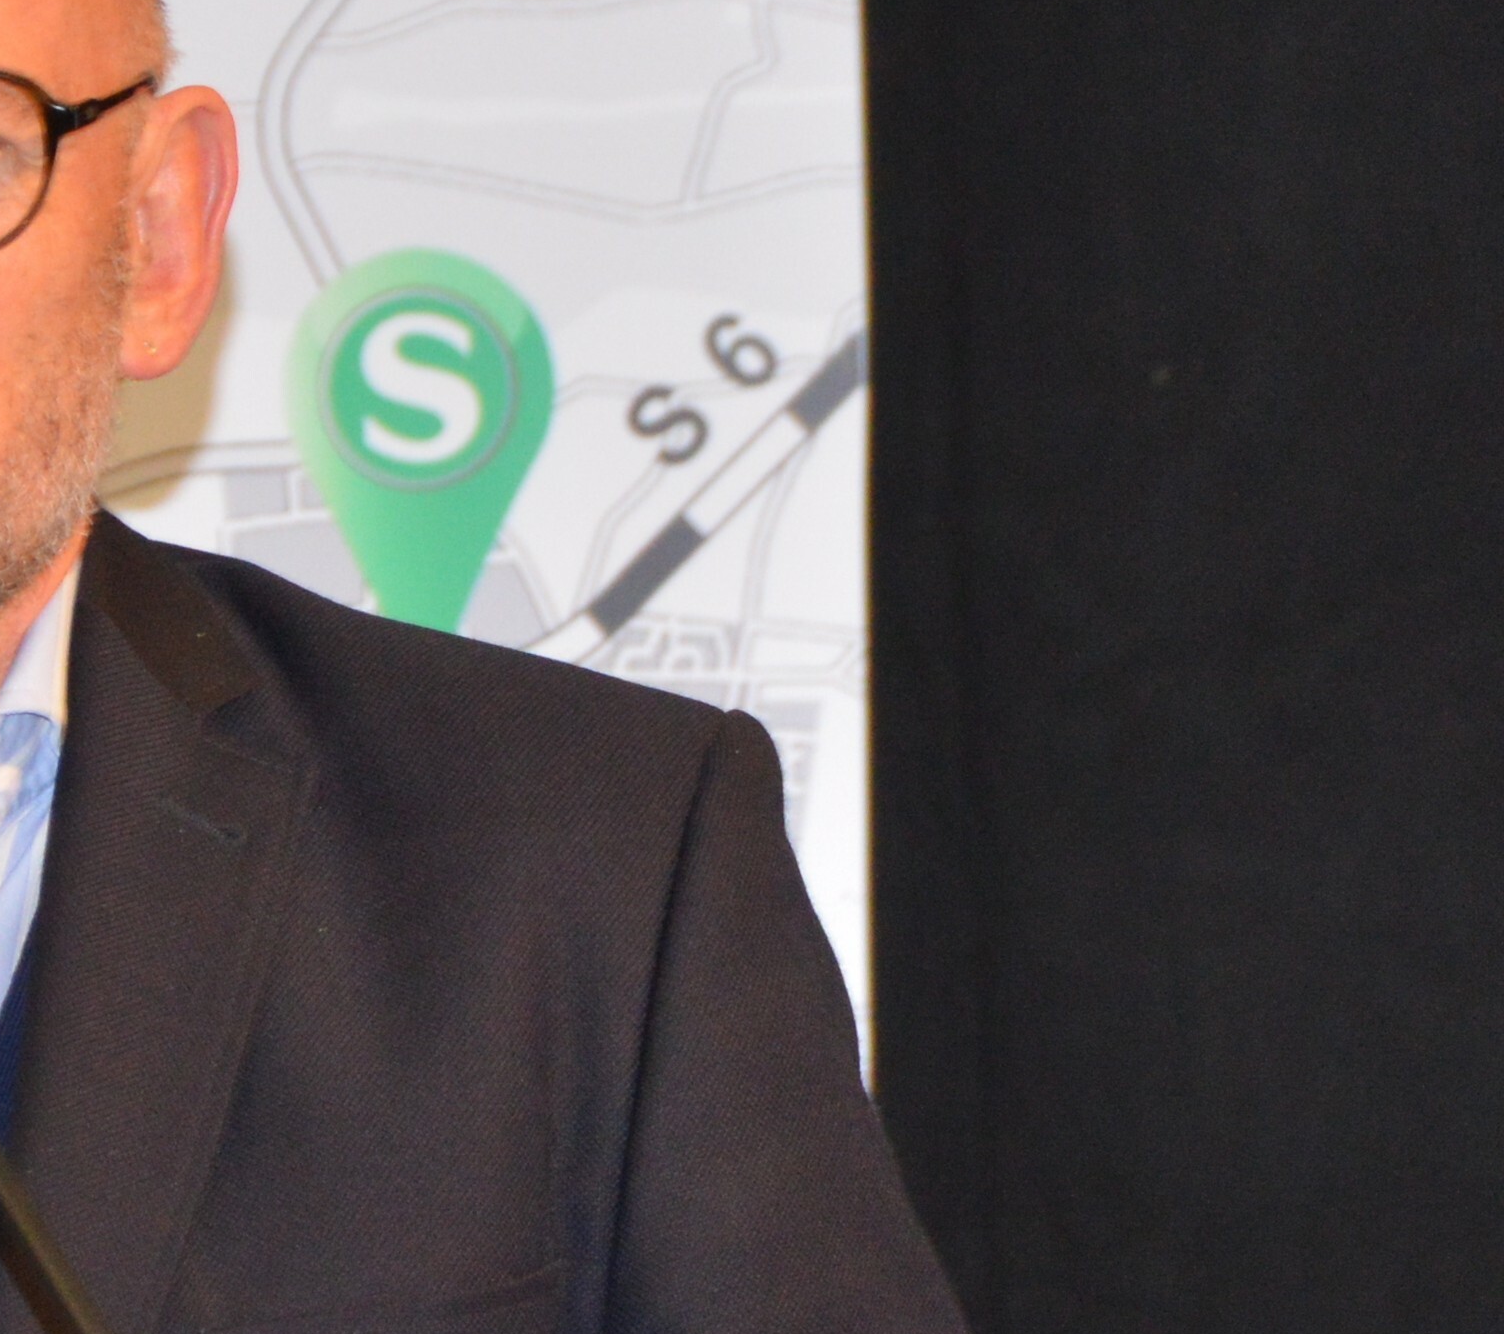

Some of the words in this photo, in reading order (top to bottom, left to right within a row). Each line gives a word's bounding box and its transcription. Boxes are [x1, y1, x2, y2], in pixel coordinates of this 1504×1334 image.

[359, 311, 482, 465] S
[627, 385, 710, 466] S
[702, 313, 778, 387] 6
